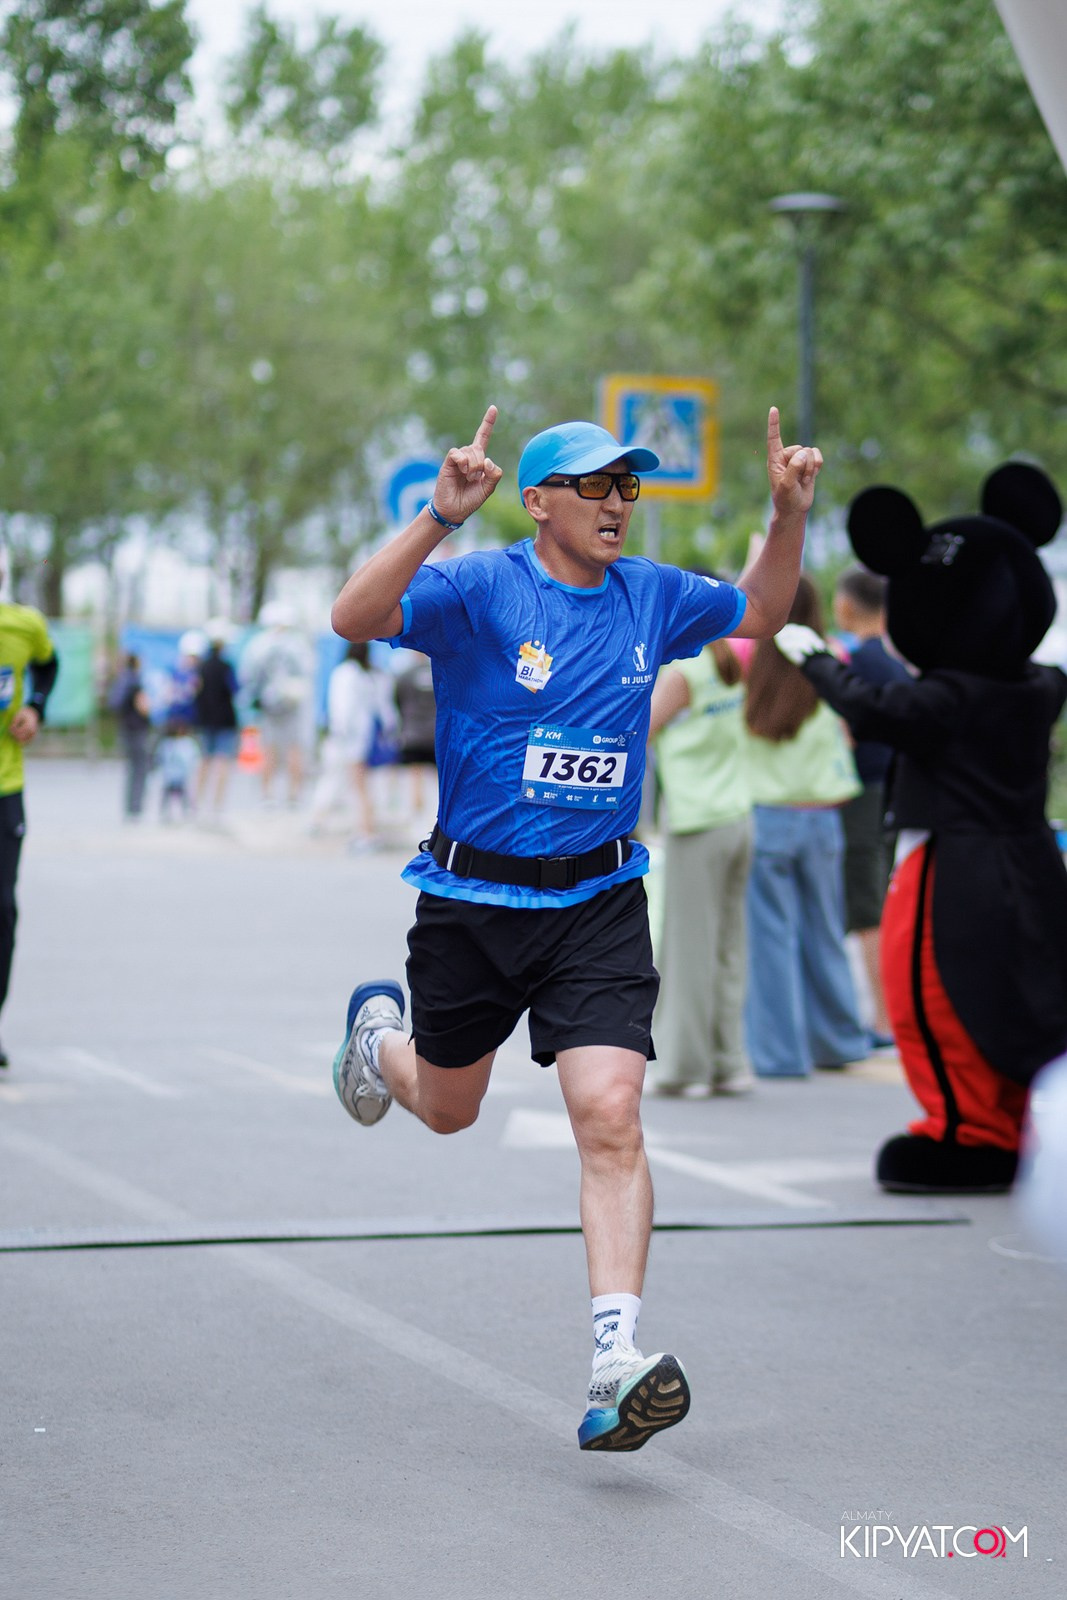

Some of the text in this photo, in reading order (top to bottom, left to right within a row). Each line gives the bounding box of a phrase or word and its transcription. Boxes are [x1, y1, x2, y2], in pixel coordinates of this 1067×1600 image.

[520, 665, 534, 677] BI
[621, 676, 630, 685] BI
[534, 727, 562, 740] 5 KM
[601, 736, 618, 744] GROUP
[539, 752, 617, 784] 1362
